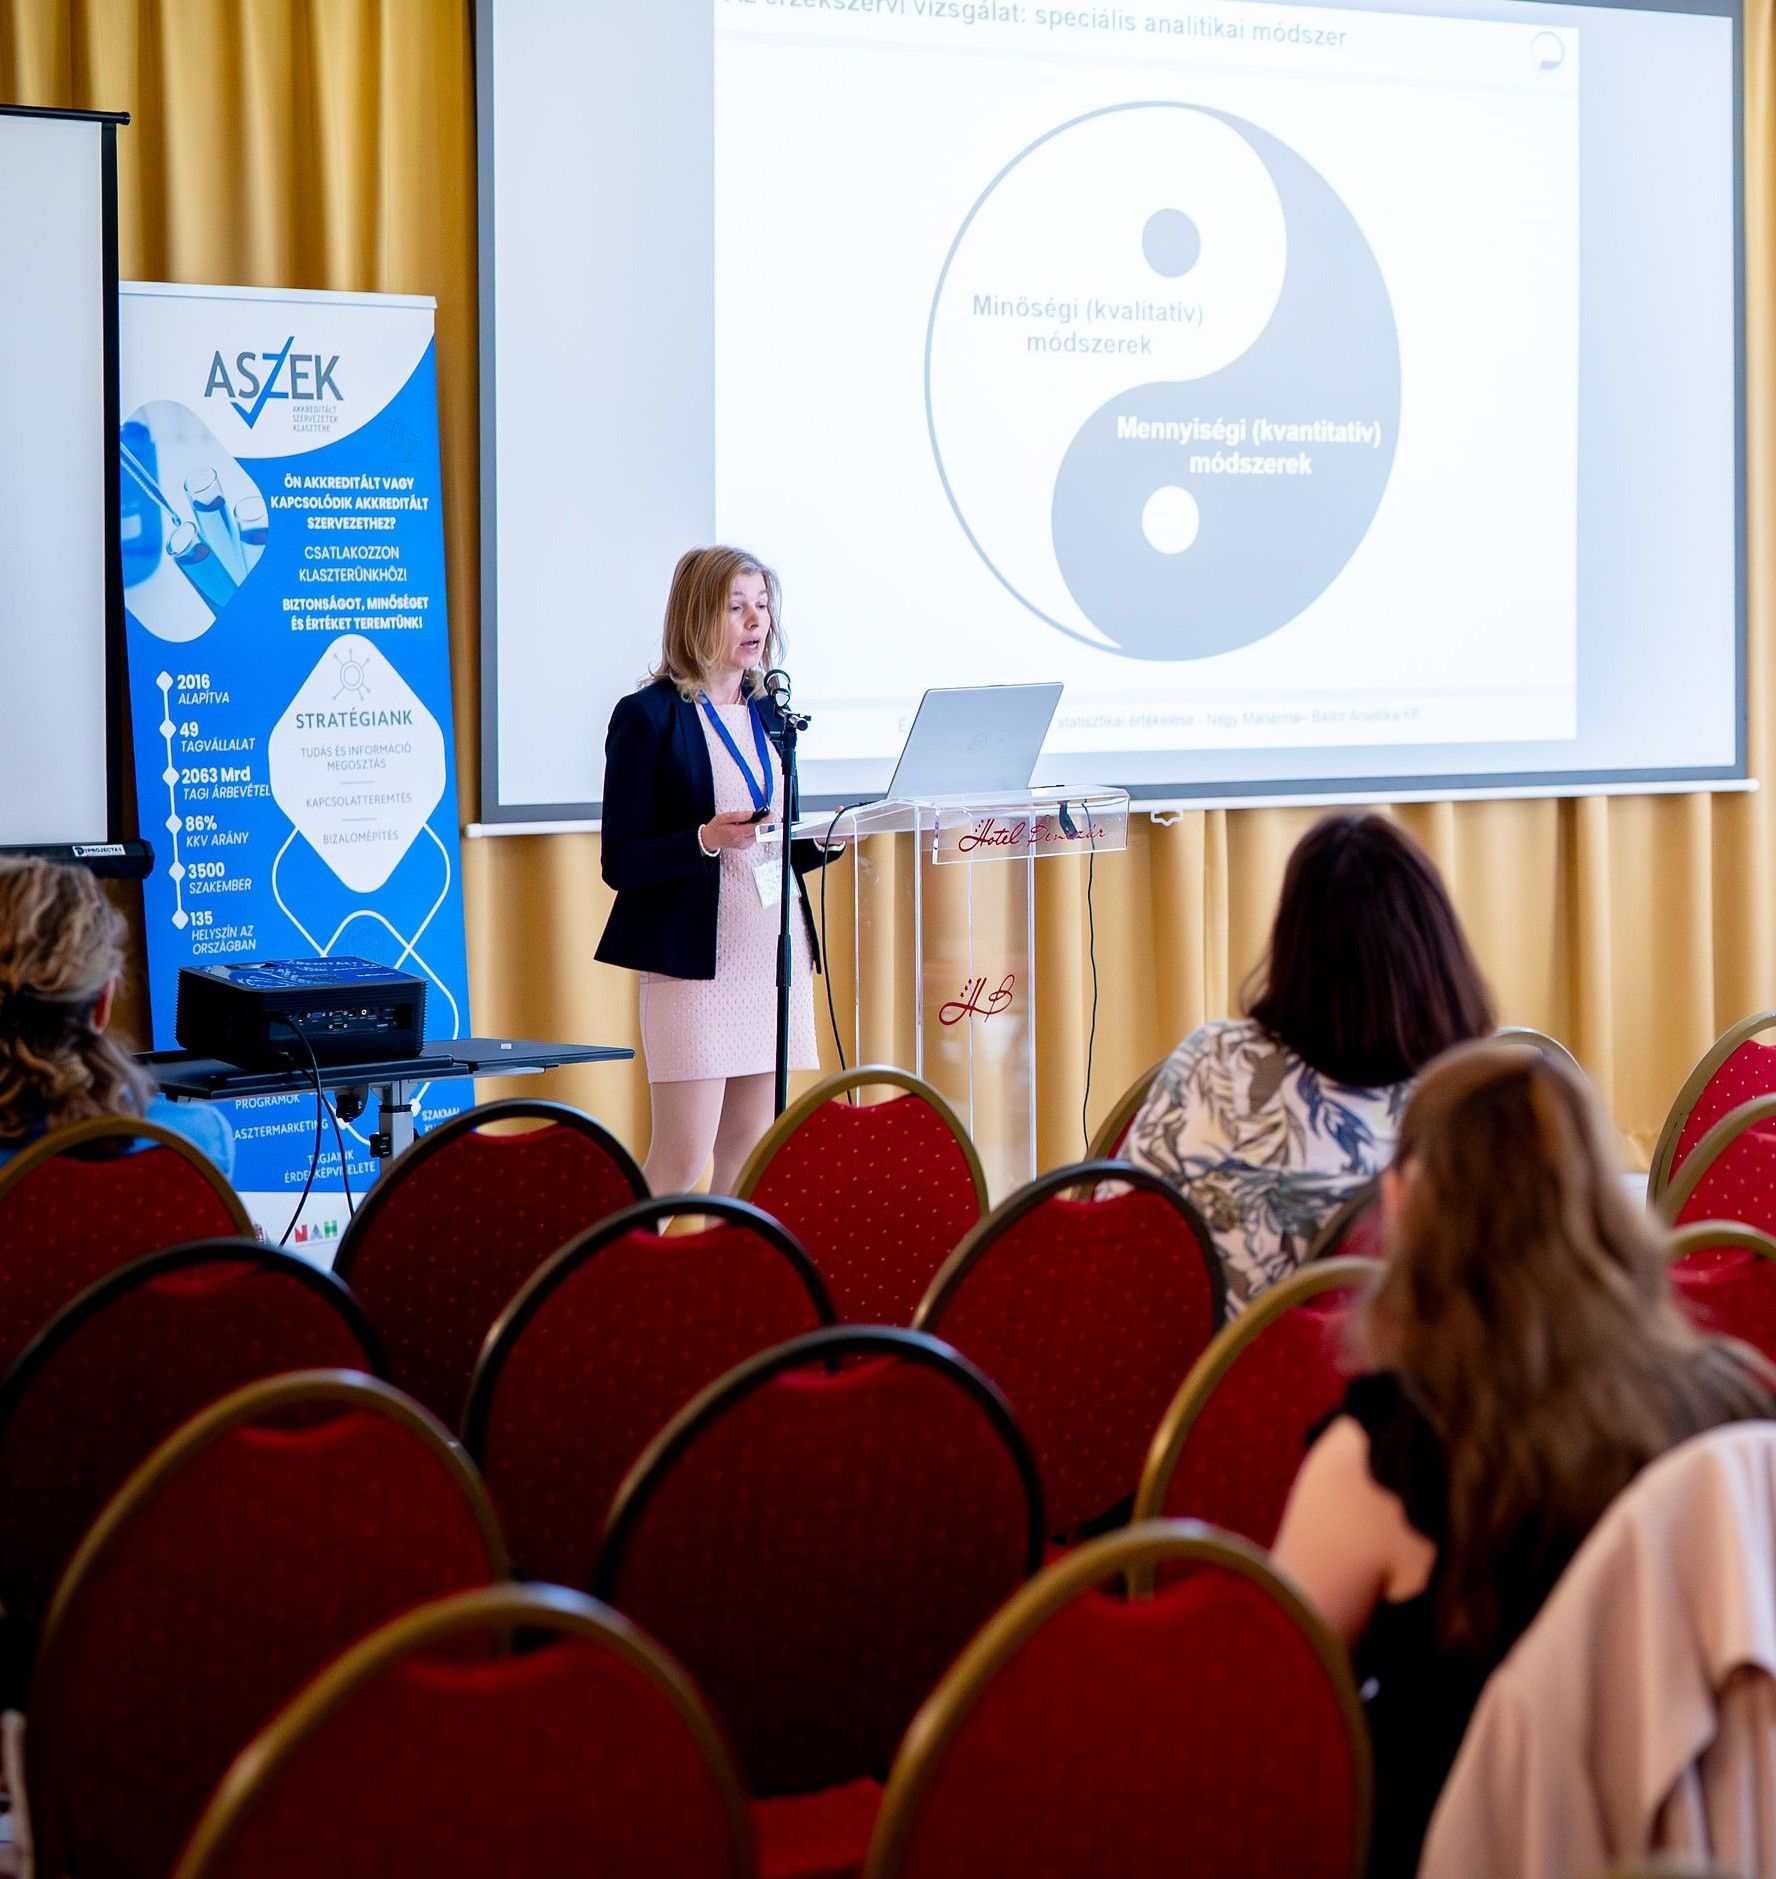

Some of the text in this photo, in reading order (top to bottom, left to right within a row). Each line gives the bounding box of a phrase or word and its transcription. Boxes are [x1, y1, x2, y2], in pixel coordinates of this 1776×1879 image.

[914, 0, 1026, 24] vizsgálat:
[1035, 8, 1136, 31] speciális
[1144, 15, 1245, 38] analitikai
[1253, 22, 1347, 46] módszer
[973, 294, 1079, 324] Minőségi
[1027, 331, 1152, 355] módszerek
[204, 336, 344, 411] ASZEK
[1117, 415, 1246, 445] Mennyiségi
[1190, 450, 1312, 475] módszerek
[284, 473, 414, 490] ÖN AKKREDITÁLT VAGY
[271, 493, 429, 511] KAPCSOLÓDIK AKKREDITÁLT
[307, 517, 397, 530] SZERVEZETHEZ?
[304, 546, 400, 560] CSATLAKOZZON
[299, 565, 407, 582] KLASZTERÜNKHÖZ!
[283, 593, 429, 612] BIZTONSÁGOT, MINŐSÉGET
[291, 614, 423, 630] ÉS ÉRTÉKET TEREMTÜNK!
[177, 673, 211, 690] 2016
[178, 690, 230, 705] ALAPÍTVA
[296, 707, 413, 729] STRATÉGIANK
[179, 721, 199, 737] 49
[181, 737, 256, 753] TAGVÁLLALAT
[300, 742, 412, 758] TUDÁS ÉS INFORMÁCIÓ
[327, 758, 387, 771] MEGOSZTÁS
[181, 766, 251, 784] 2063 Mrd
[184, 782, 272, 800] TAGI ÁRBEVÉTEL
[306, 792, 413, 808] KAPCSOLATTEREMTÉS
[185, 816, 218, 831] 86%
[186, 831, 249, 847] KKV ARÁNY
[323, 829, 399, 844] BIZALOMÉPÍTÉS
[959, 818, 1026, 852] Hotel
[188, 862, 225, 879] 3500
[189, 878, 252, 894] SZAKEMBER
[190, 911, 213, 926] 135
[192, 924, 254, 941] HELYSZÍN AZ
[192, 938, 256, 955] ORSZÁGBAN
[235, 1094, 301, 1110] PROGRAMOK
[285, 1161, 376, 1183] ÉRDEKÉPVIELETE
